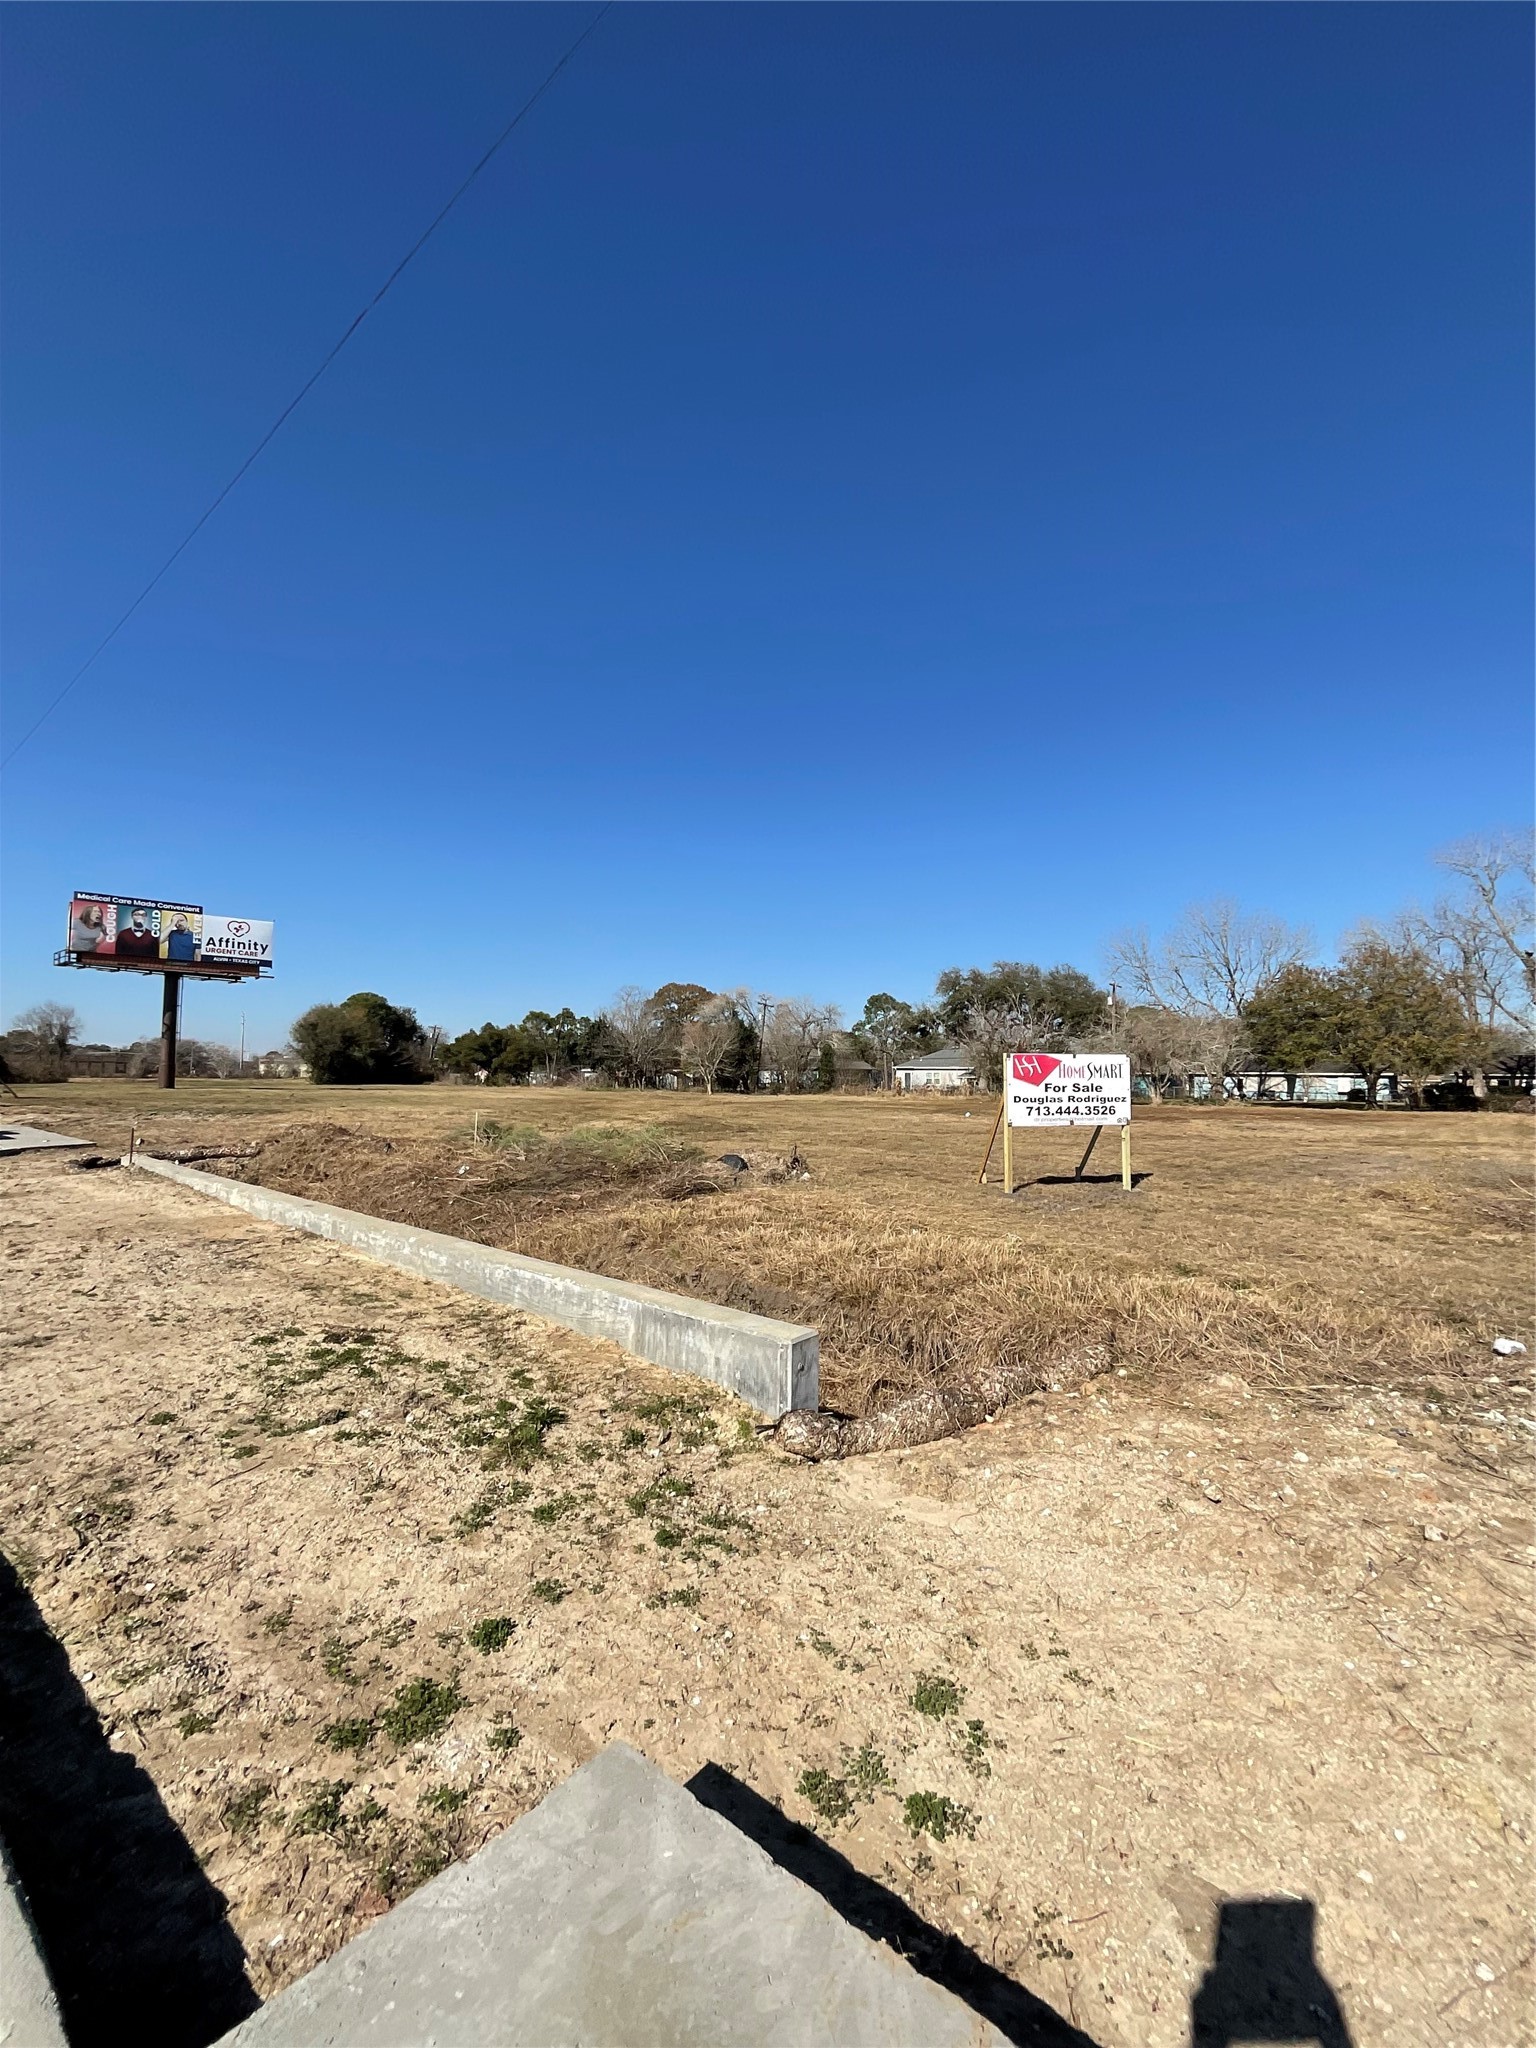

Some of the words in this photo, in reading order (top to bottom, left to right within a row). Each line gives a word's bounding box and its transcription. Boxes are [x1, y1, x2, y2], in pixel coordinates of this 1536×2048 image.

[77, 893, 111, 902] Medical
[112, 896, 132, 905] Care
[133, 899, 156, 908] Made
[157, 902, 200, 912] Convenient
[106, 904, 118, 943] COUGH
[151, 909, 161, 938] COLD
[193, 914, 203, 944] FEVER
[205, 936, 269, 955] Affinity
[205, 947, 237, 956] URGENT
[238, 949, 259, 958] CARE
[1044, 1083, 1067, 1092] For
[1072, 1083, 1103, 1093] Sale
[1013, 1095, 1064, 1104] Douglas
[1067, 1095, 1127, 1104] Rodriguez
[1026, 1106, 1116, 1116] 713.444.3526
